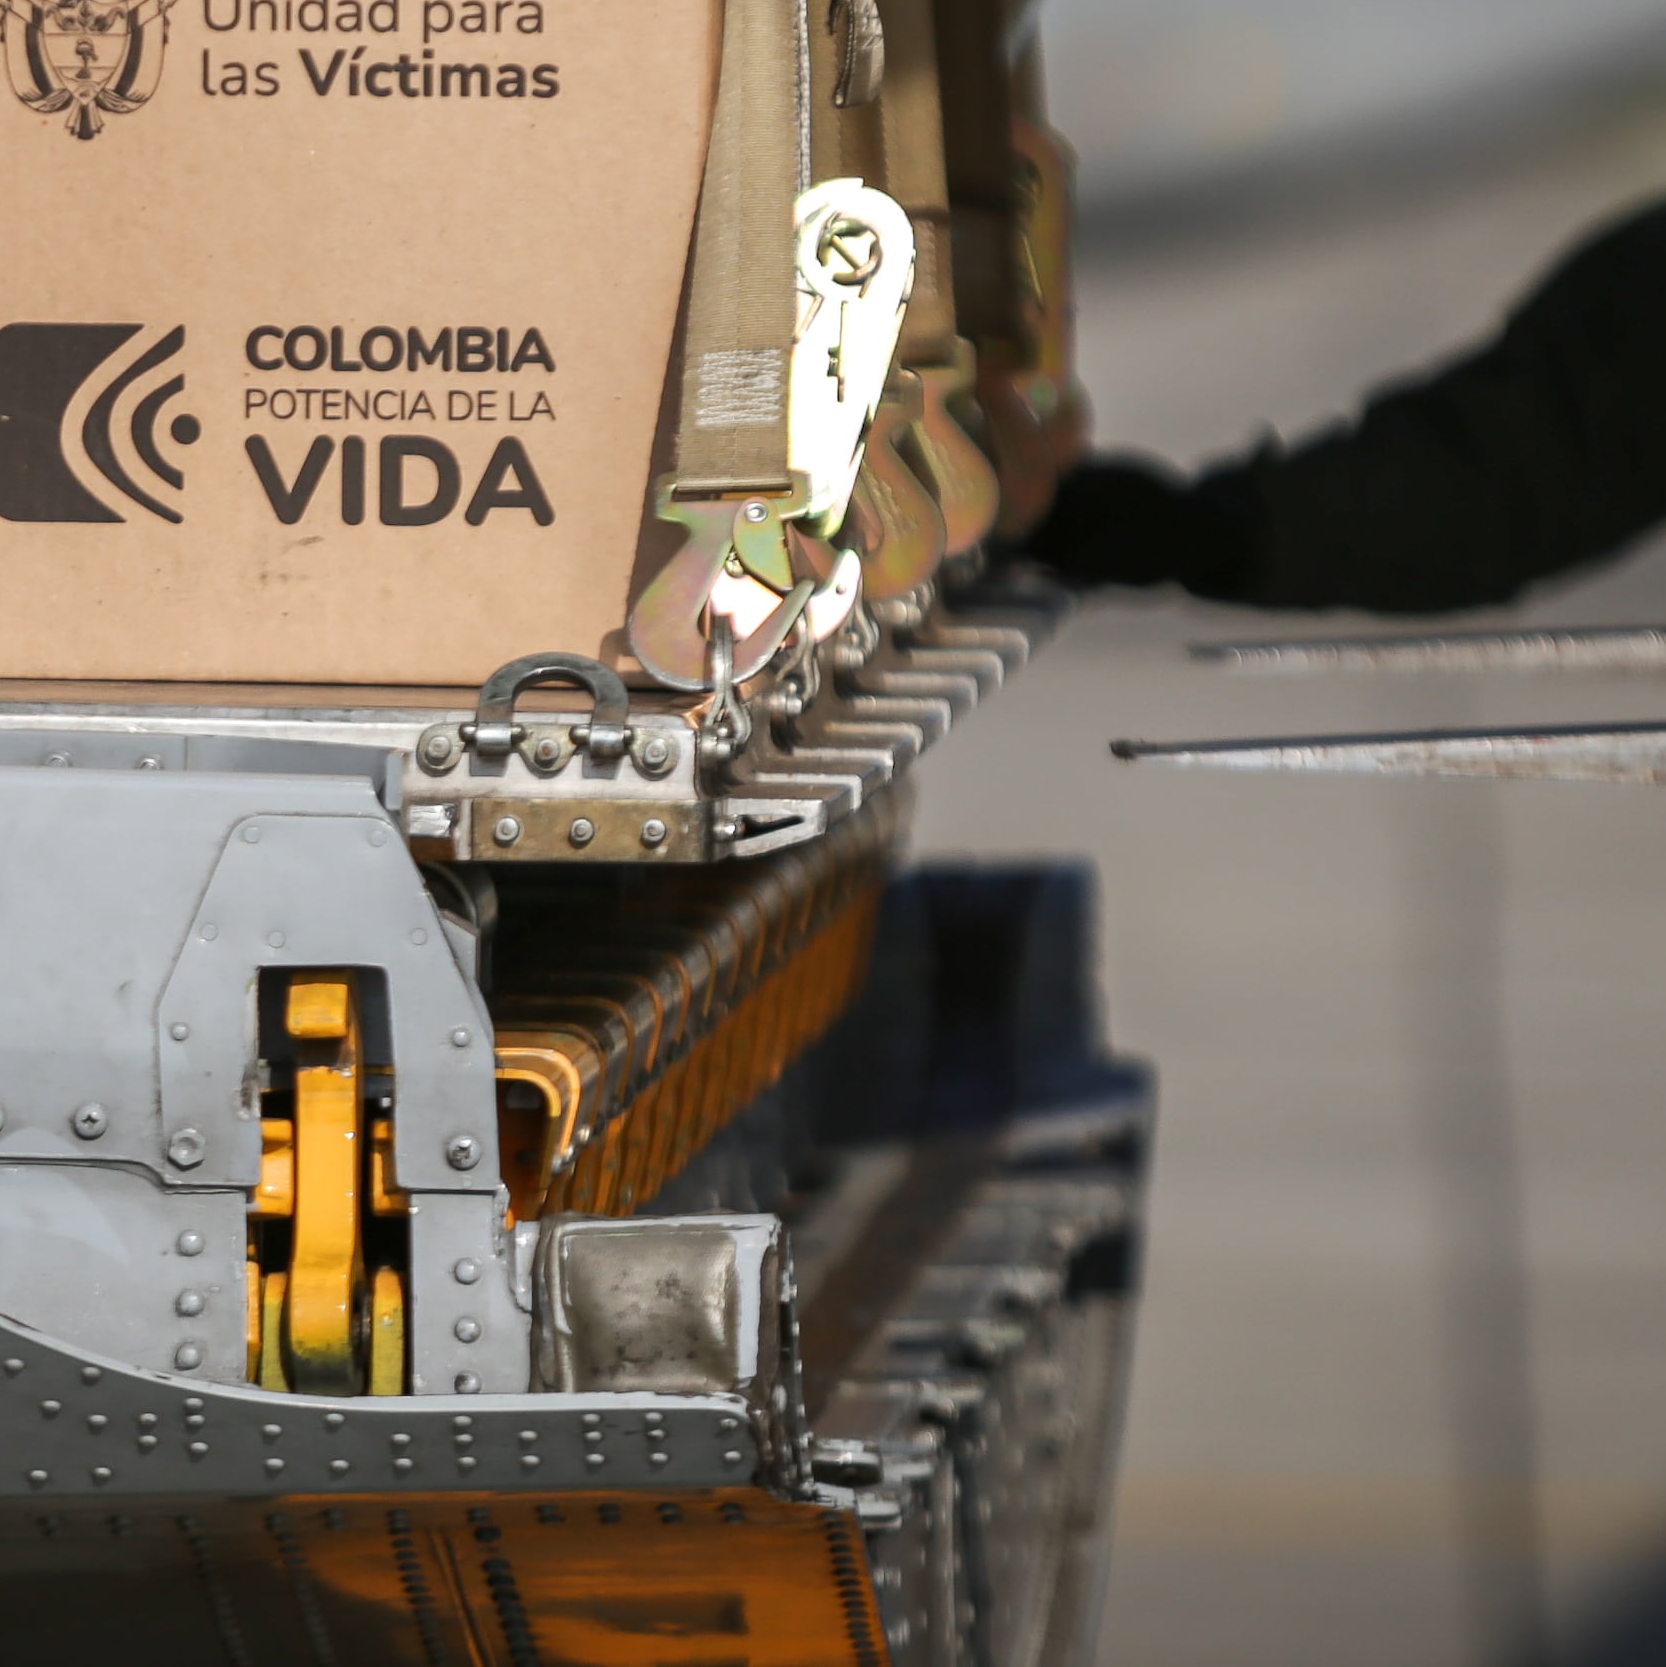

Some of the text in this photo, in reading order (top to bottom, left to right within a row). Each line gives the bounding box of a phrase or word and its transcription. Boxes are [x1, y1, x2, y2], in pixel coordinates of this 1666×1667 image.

[200, 46, 561, 100] las Víctimas
[244, 324, 557, 375] COLOMBIA
[244, 388, 557, 422] POTENCIA DE LA
[244, 433, 557, 528] VIDA
